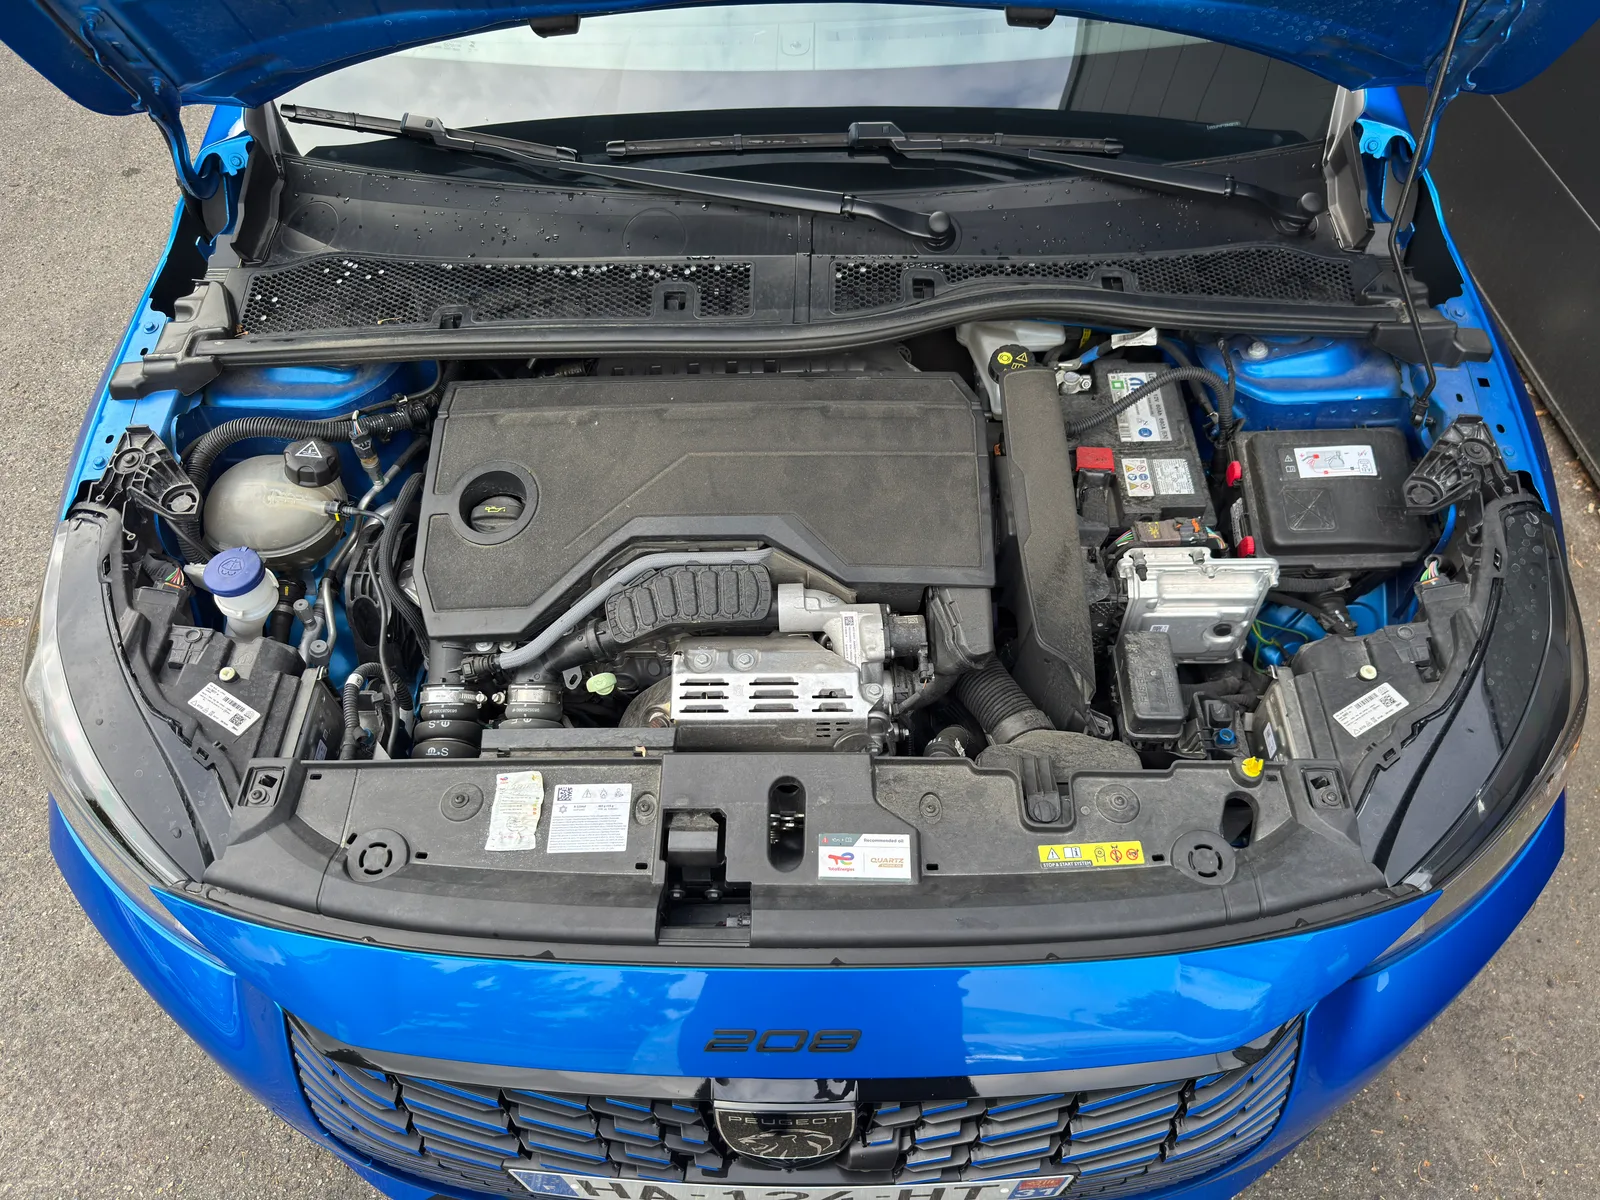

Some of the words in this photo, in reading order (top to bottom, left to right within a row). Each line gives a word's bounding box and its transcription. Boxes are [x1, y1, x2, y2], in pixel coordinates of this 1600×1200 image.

[1165, 681, 1175, 704] FUSE
[704, 1029, 862, 1052] 208
[728, 1115, 843, 1126] PEUGEOT
[1014, 1187, 1055, 1198] 31
